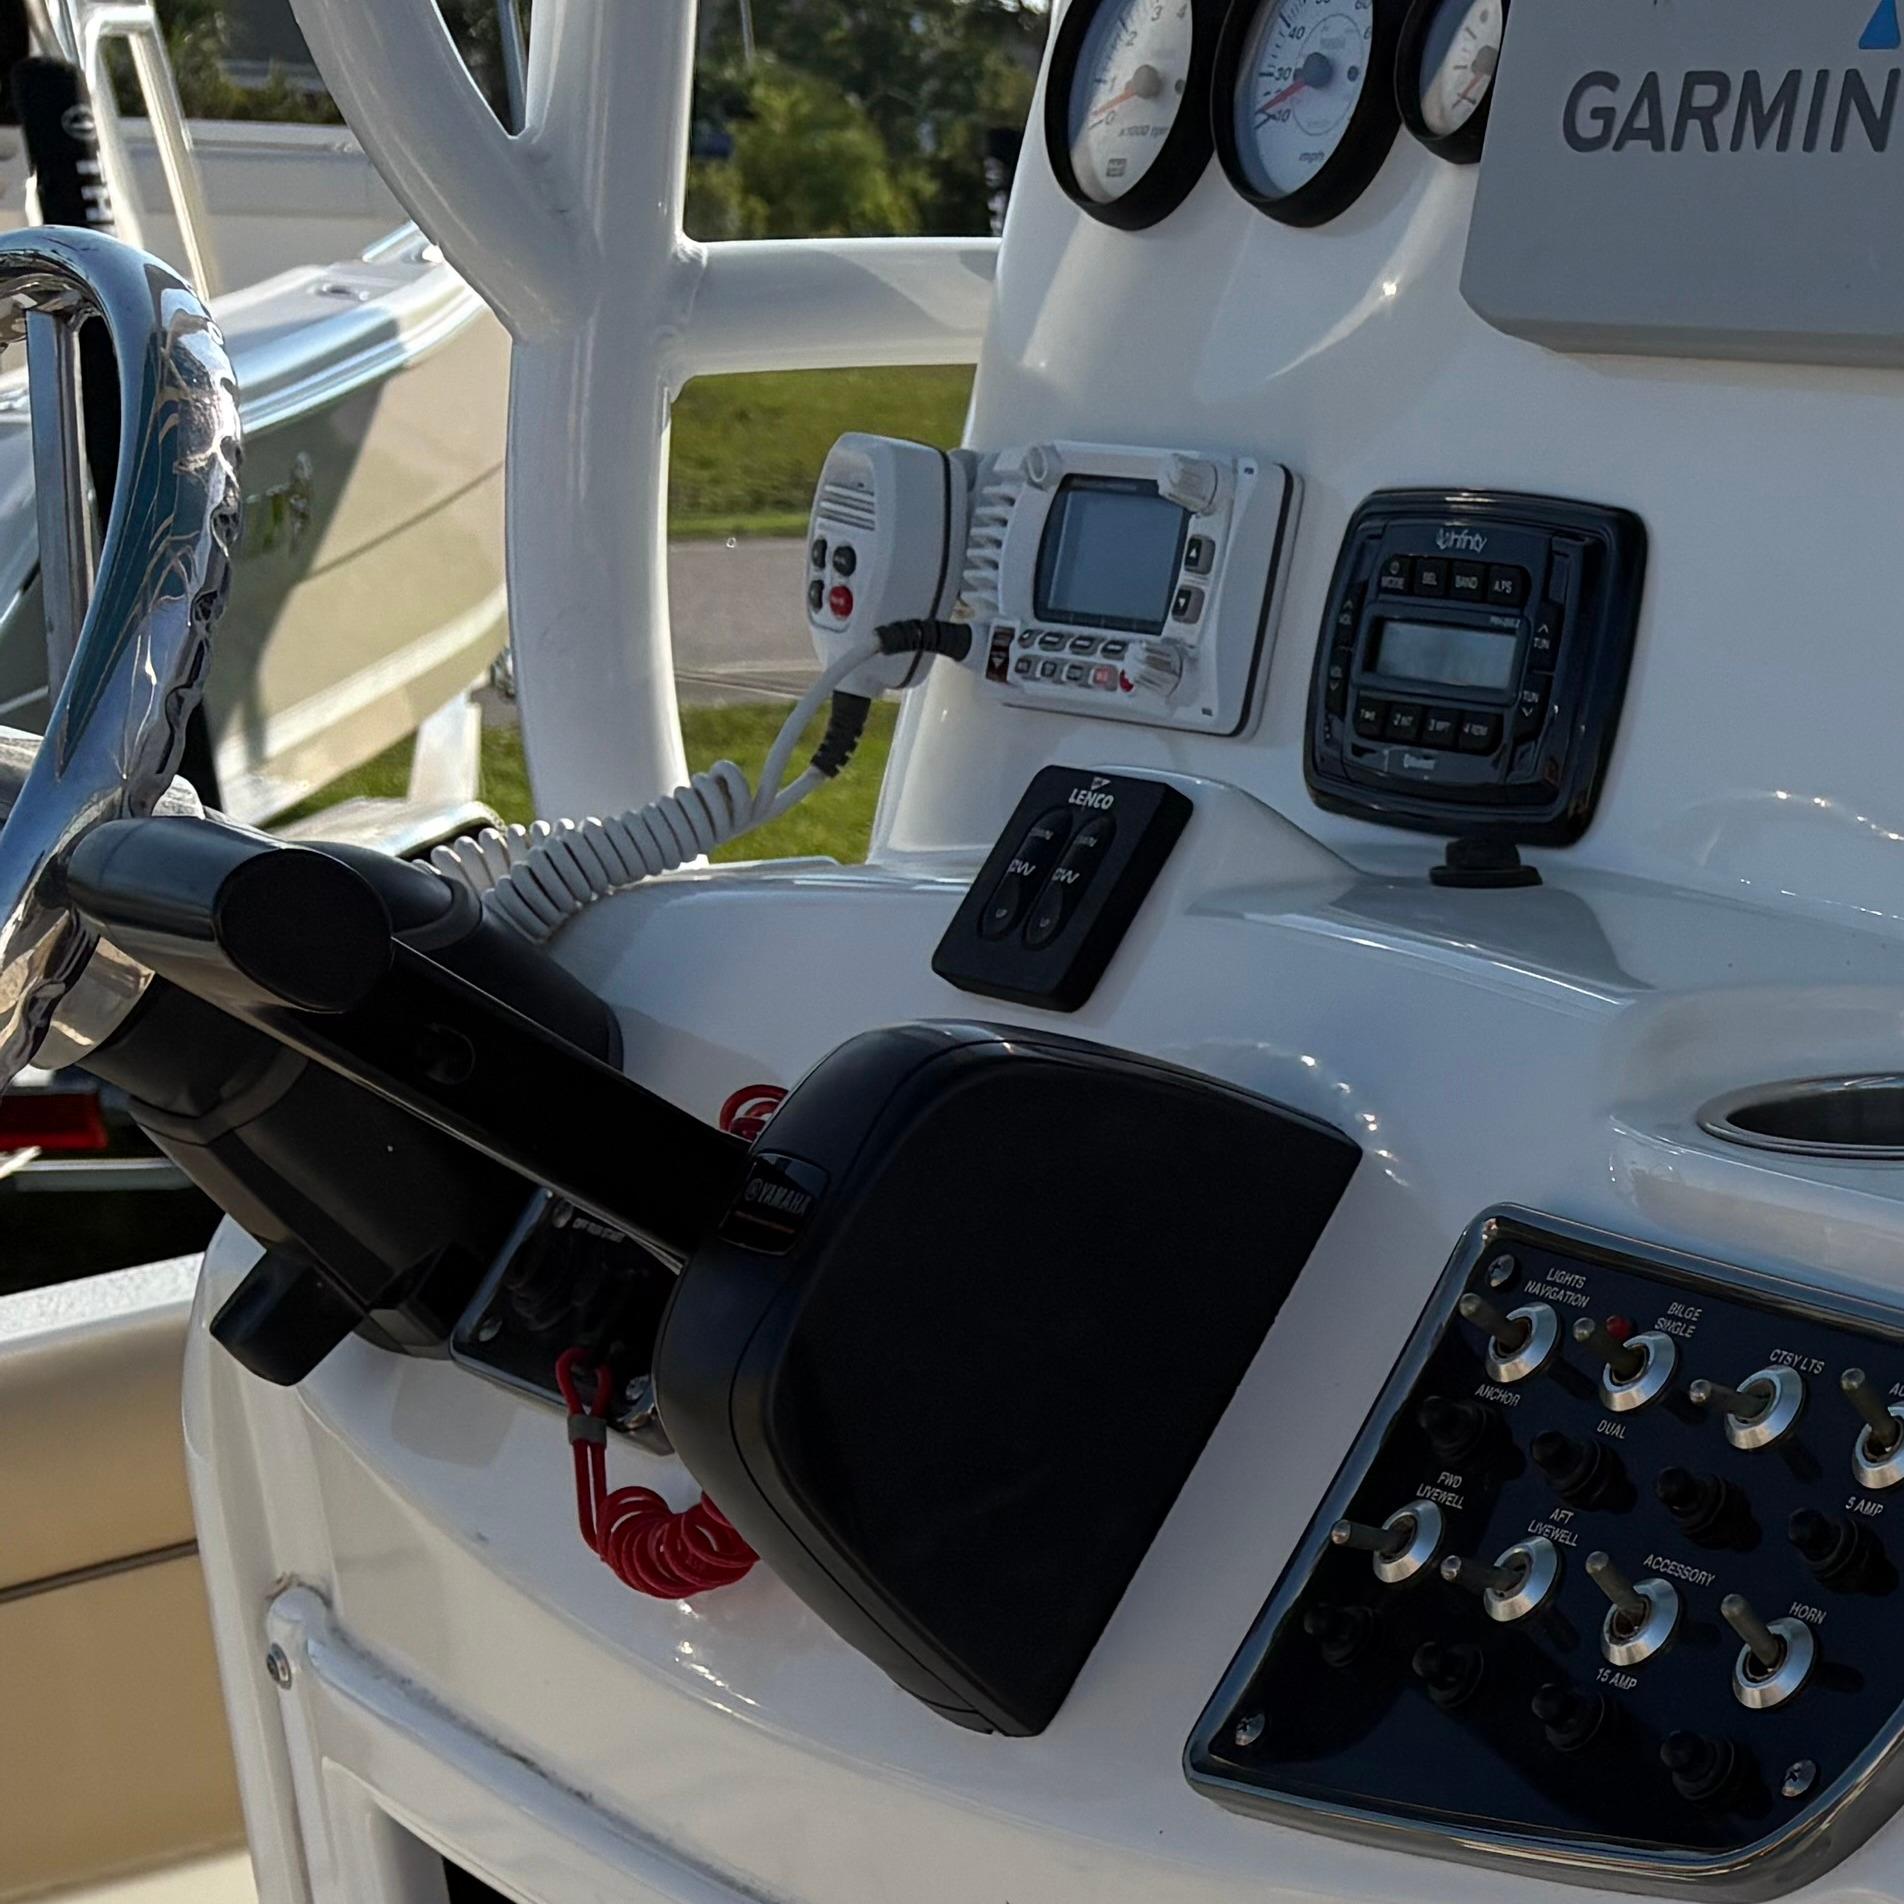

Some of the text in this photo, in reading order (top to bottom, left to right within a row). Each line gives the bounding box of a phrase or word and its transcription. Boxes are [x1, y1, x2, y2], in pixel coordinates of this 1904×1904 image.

[1151, 5, 1163, 21] 3
[1125, 31, 1138, 46] 2
[1289, 25, 1306, 40] 40
[1274, 67, 1292, 81] 30
[1562, 68, 1902, 153] GARMIN
[1068, 787, 1114, 810] LENCO
[758, 1181, 812, 1216] YAMAHA
[1546, 1267, 1586, 1288] LIGHTS
[1524, 1280, 1590, 1308] NAVIGATION
[1668, 1302, 1702, 1322] BILGE
[1654, 1317, 1696, 1338] SINGLE
[1769, 1348, 1825, 1375] CTSY LTS
[1474, 1383, 1521, 1407] ANCHOR
[1597, 1419, 1627, 1439] DUAL
[1437, 1471, 1462, 1488] FWD
[1416, 1483, 1463, 1510] LIVEWELL
[1845, 1496, 1884, 1517] 5 AMP
[1550, 1508, 1574, 1524] AFT
[1528, 1519, 1578, 1547] LIVEWELL
[1643, 1554, 1716, 1588] ACCESSORY
[1788, 1602, 1827, 1625] HORN
[1596, 1667, 1638, 1691] 15 AMP
